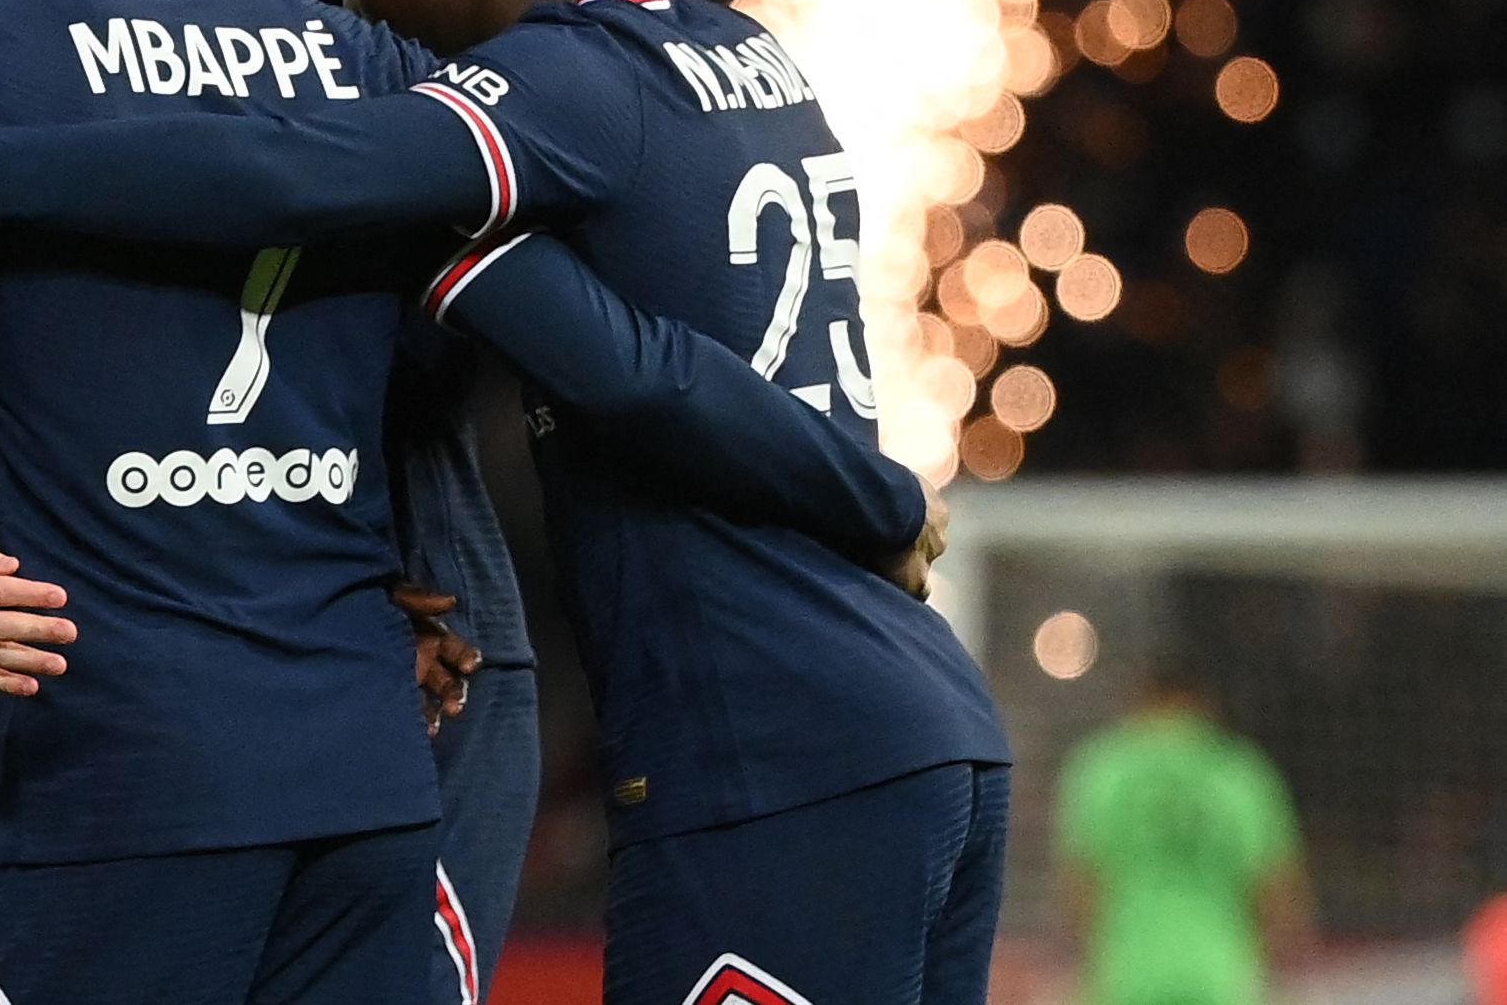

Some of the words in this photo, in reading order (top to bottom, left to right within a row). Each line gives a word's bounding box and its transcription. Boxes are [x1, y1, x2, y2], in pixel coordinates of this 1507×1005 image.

[69, 18, 360, 99] MBAPPÉ
[428, 62, 510, 106] NB
[727, 150, 878, 419] 25
